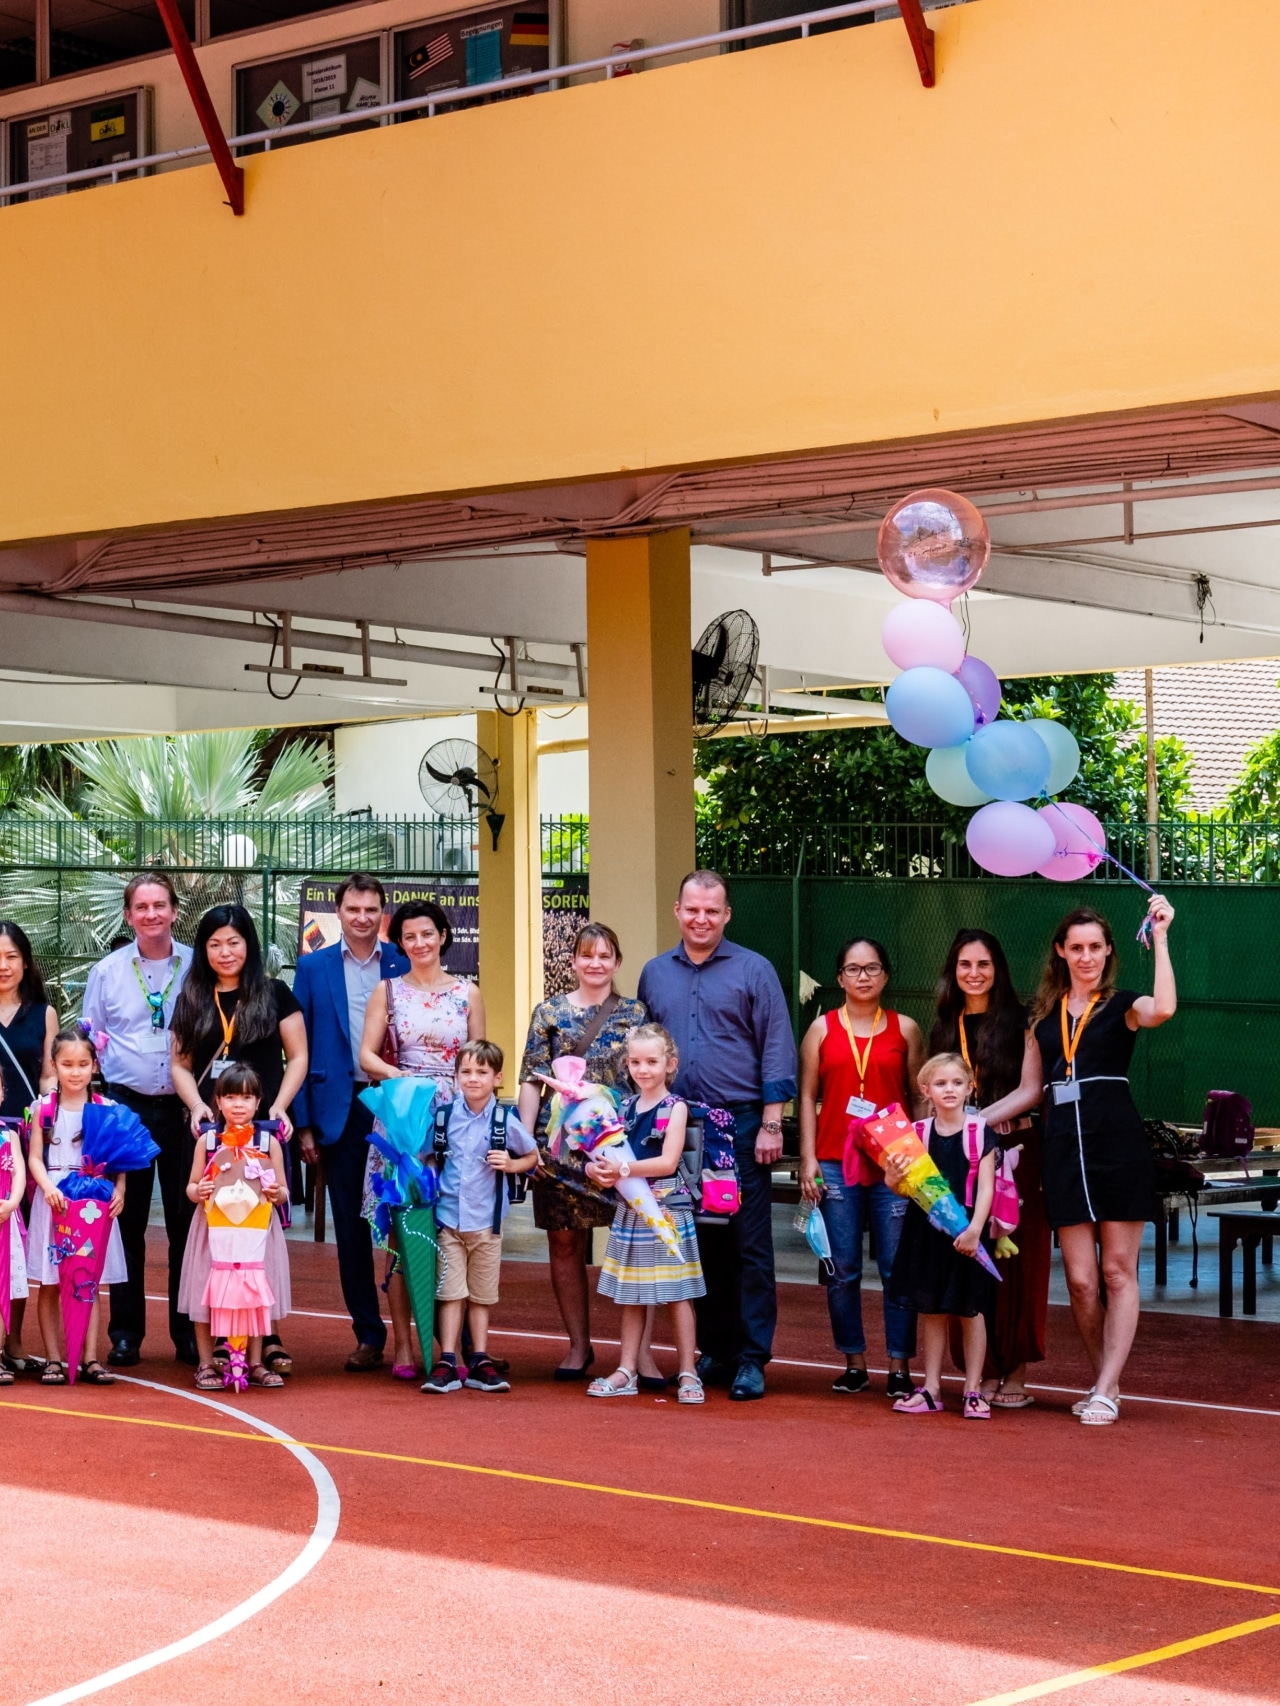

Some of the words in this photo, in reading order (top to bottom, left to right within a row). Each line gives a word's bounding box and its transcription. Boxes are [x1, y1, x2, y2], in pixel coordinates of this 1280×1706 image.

[306, 887, 325, 902] Ein
[393, 890, 437, 904] DANKE
[440, 895, 455, 907] an
